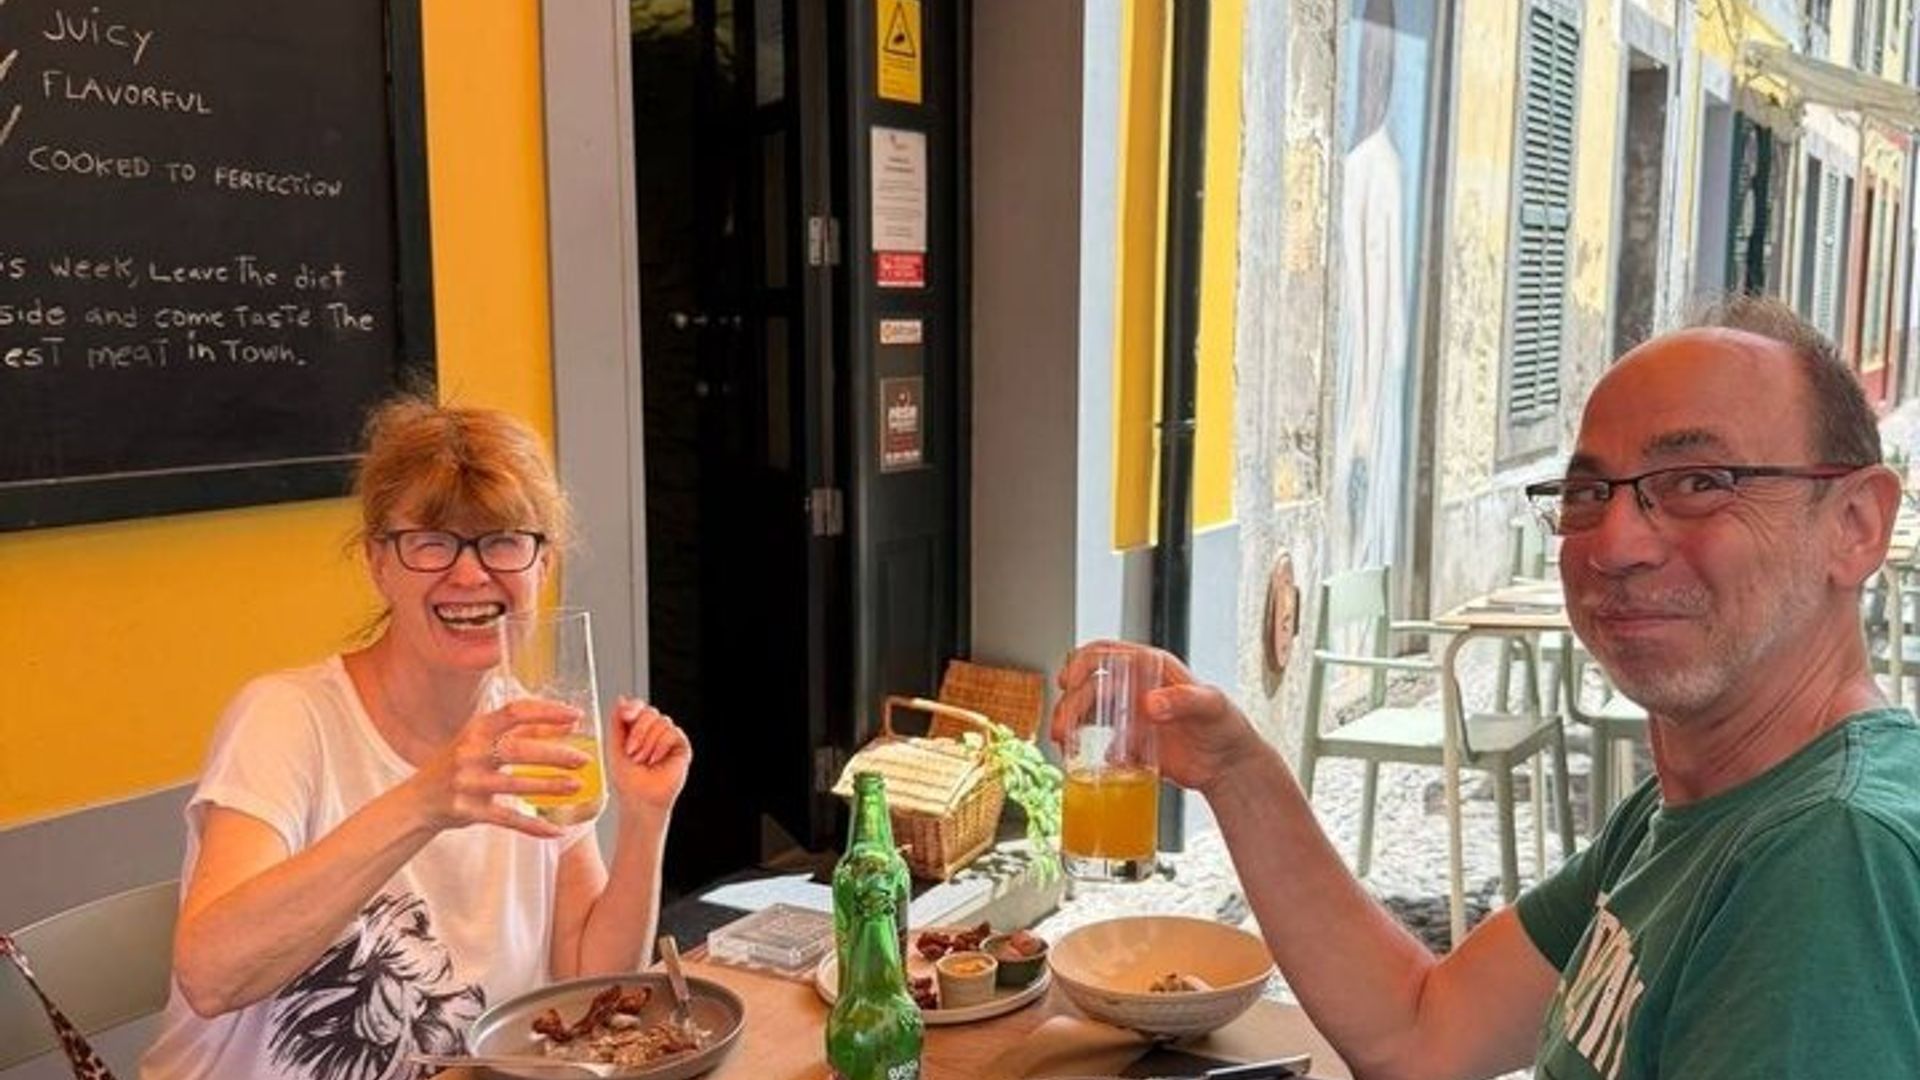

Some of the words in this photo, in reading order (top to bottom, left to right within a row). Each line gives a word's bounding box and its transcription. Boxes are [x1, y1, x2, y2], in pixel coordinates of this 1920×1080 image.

[42, 69, 212, 114] FLAVORFUL
[28, 145, 150, 179] COOKED
[167, 162, 197, 182] TO
[214, 166, 343, 197] PERFECTION
[148, 262, 228, 283] Leave
[85, 306, 138, 328] and
[154, 308, 225, 328] come
[187, 330, 216, 362] in
